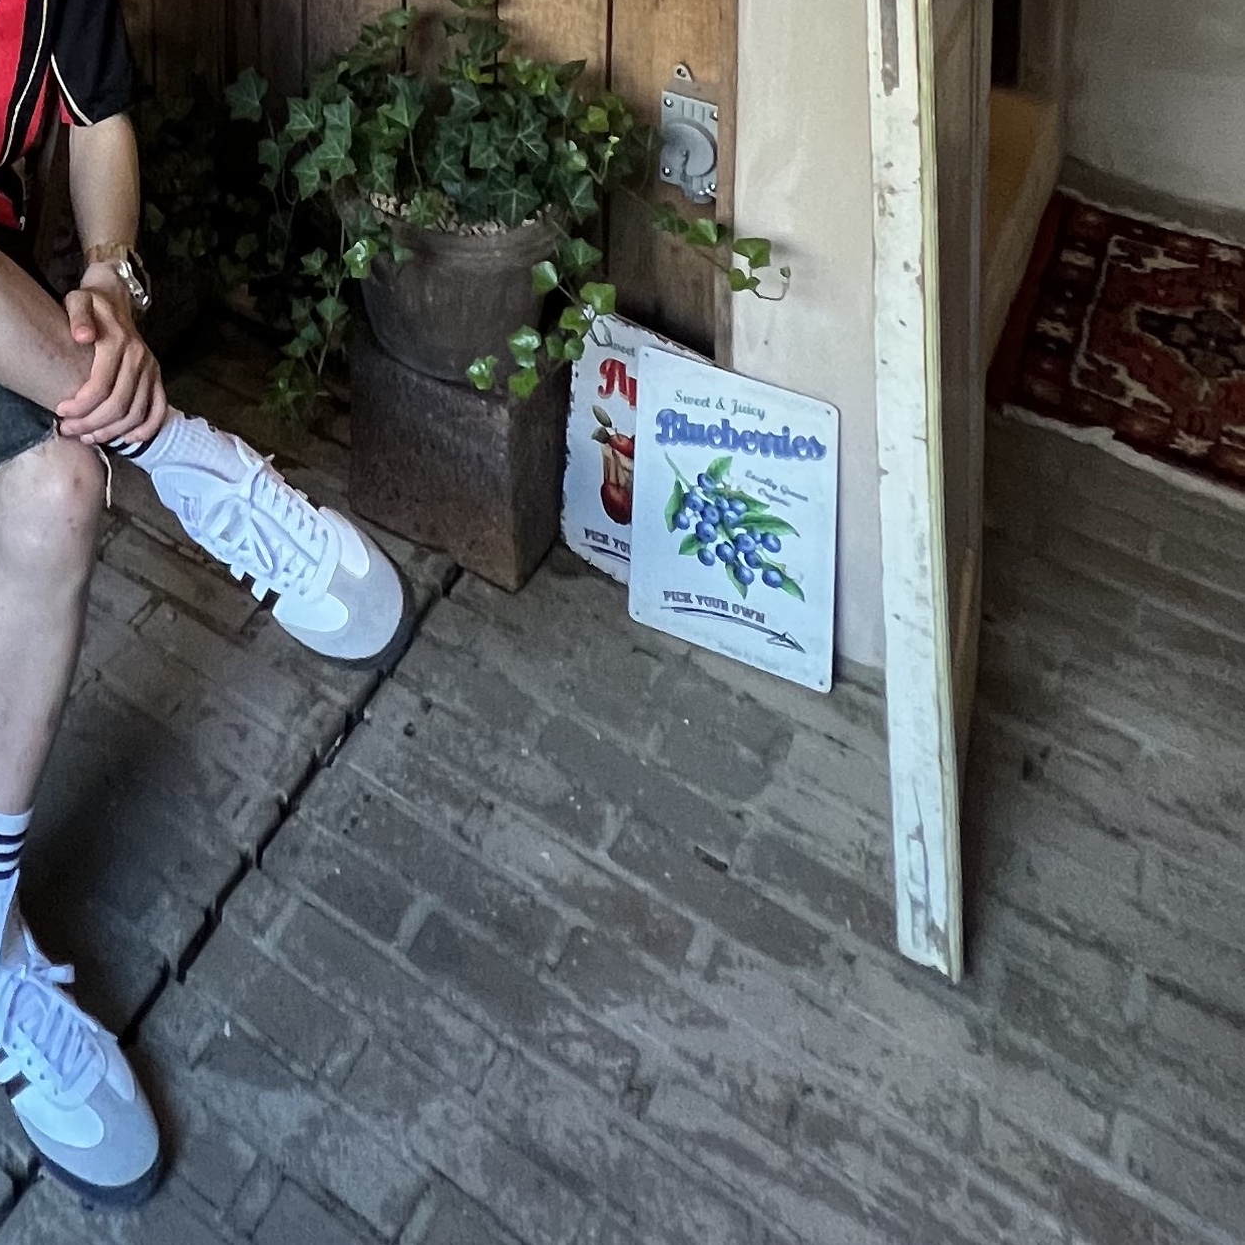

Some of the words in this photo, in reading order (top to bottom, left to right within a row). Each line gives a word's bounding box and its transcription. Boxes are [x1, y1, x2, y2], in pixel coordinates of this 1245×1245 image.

[674, 389, 711, 409] Sweet
[715, 395, 726, 411] &
[730, 398, 766, 422] Juicy
[655, 408, 828, 461] Blueberries
[612, 537, 632, 555] YOU
[663, 589, 693, 604] PICK
[695, 593, 729, 612] YOUR
[731, 602, 766, 624] OWN
